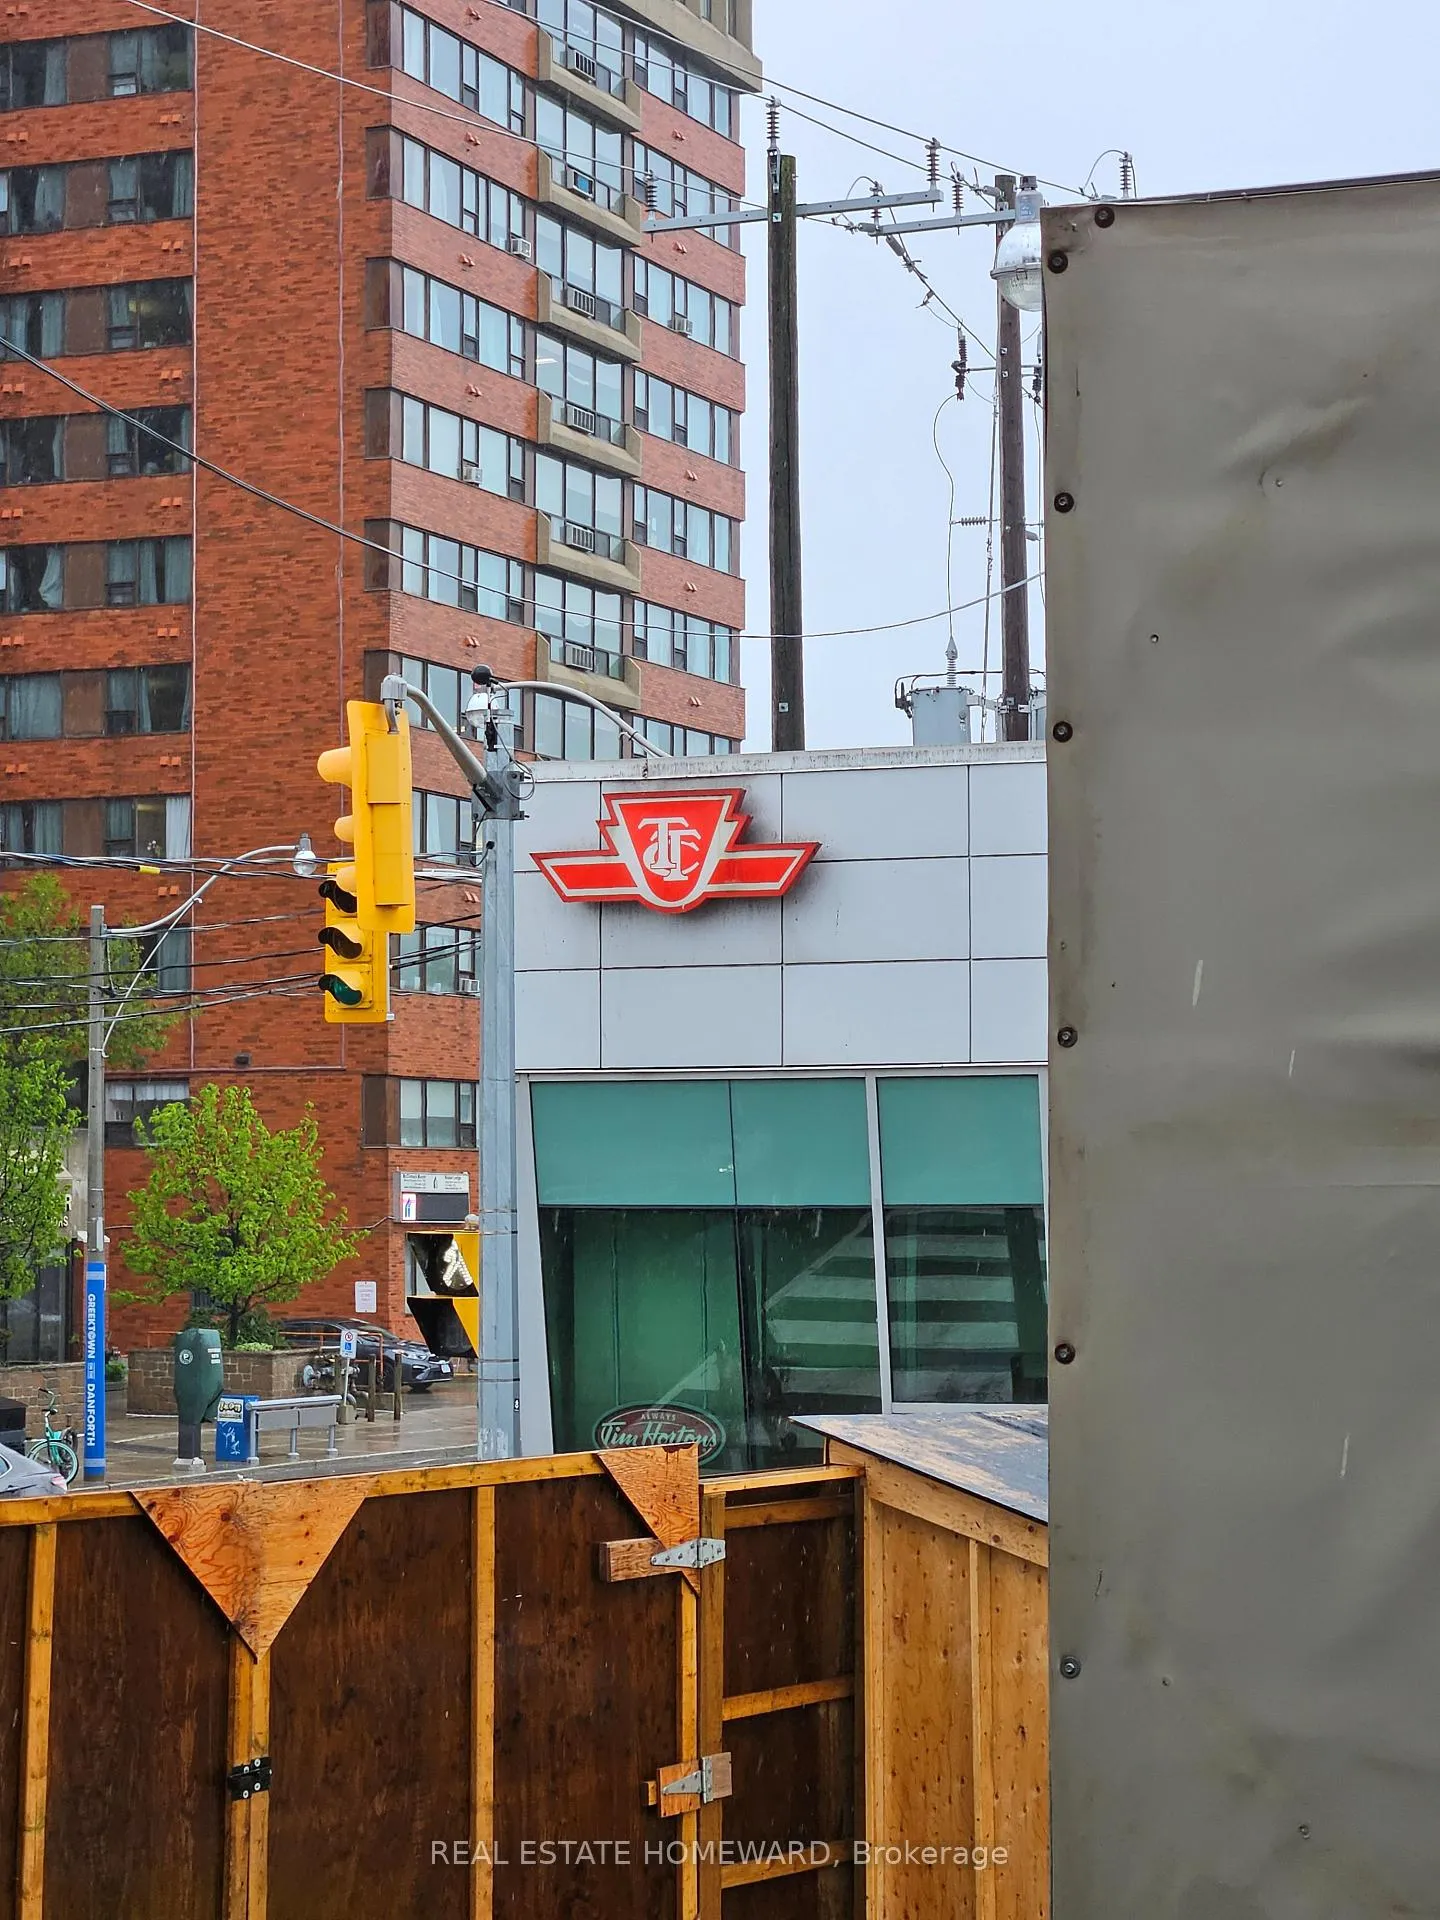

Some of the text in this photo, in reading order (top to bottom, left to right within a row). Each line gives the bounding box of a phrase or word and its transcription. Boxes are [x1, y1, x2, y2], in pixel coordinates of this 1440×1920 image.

[87, 1293, 96, 1359] GREEKTOWN
[87, 1383, 96, 1447] DANFORTH
[601, 1421, 717, 1448] Tim Hortons
[640, 1412, 677, 1422] ALWAYS
